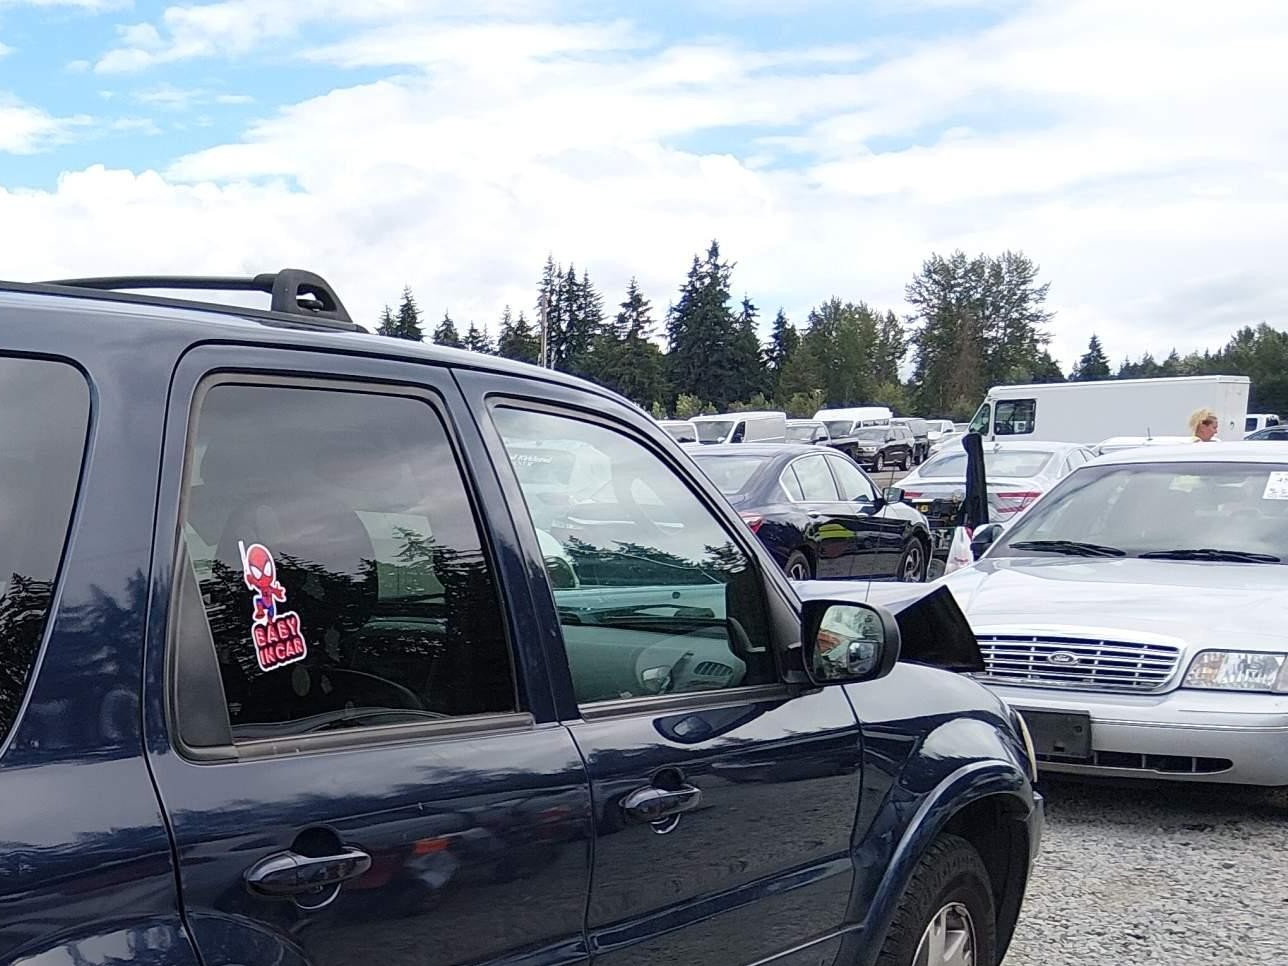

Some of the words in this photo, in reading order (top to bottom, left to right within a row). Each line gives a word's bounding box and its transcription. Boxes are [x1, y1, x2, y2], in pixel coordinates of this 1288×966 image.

[255, 617, 297, 646] BABY
[259, 647, 276, 665] IN
[276, 638, 303, 659] CAR
